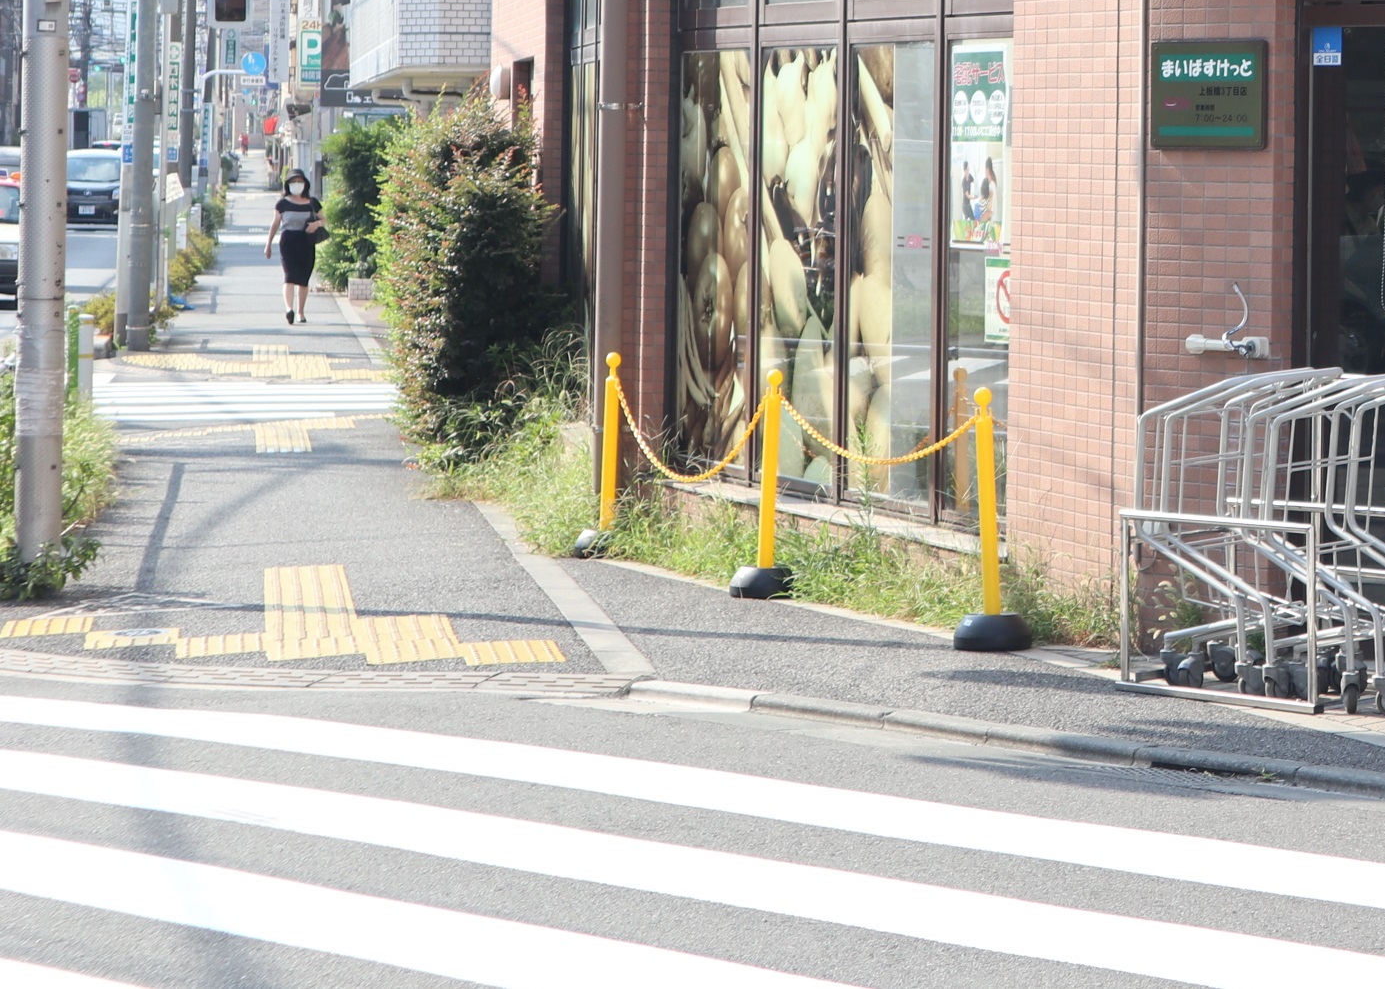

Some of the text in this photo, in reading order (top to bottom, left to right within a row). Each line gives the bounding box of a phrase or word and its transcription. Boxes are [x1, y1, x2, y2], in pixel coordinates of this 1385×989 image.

[954, 61, 1005, 86] 宅配サービス
[1161, 59, 1252, 78] まいばすけっと
